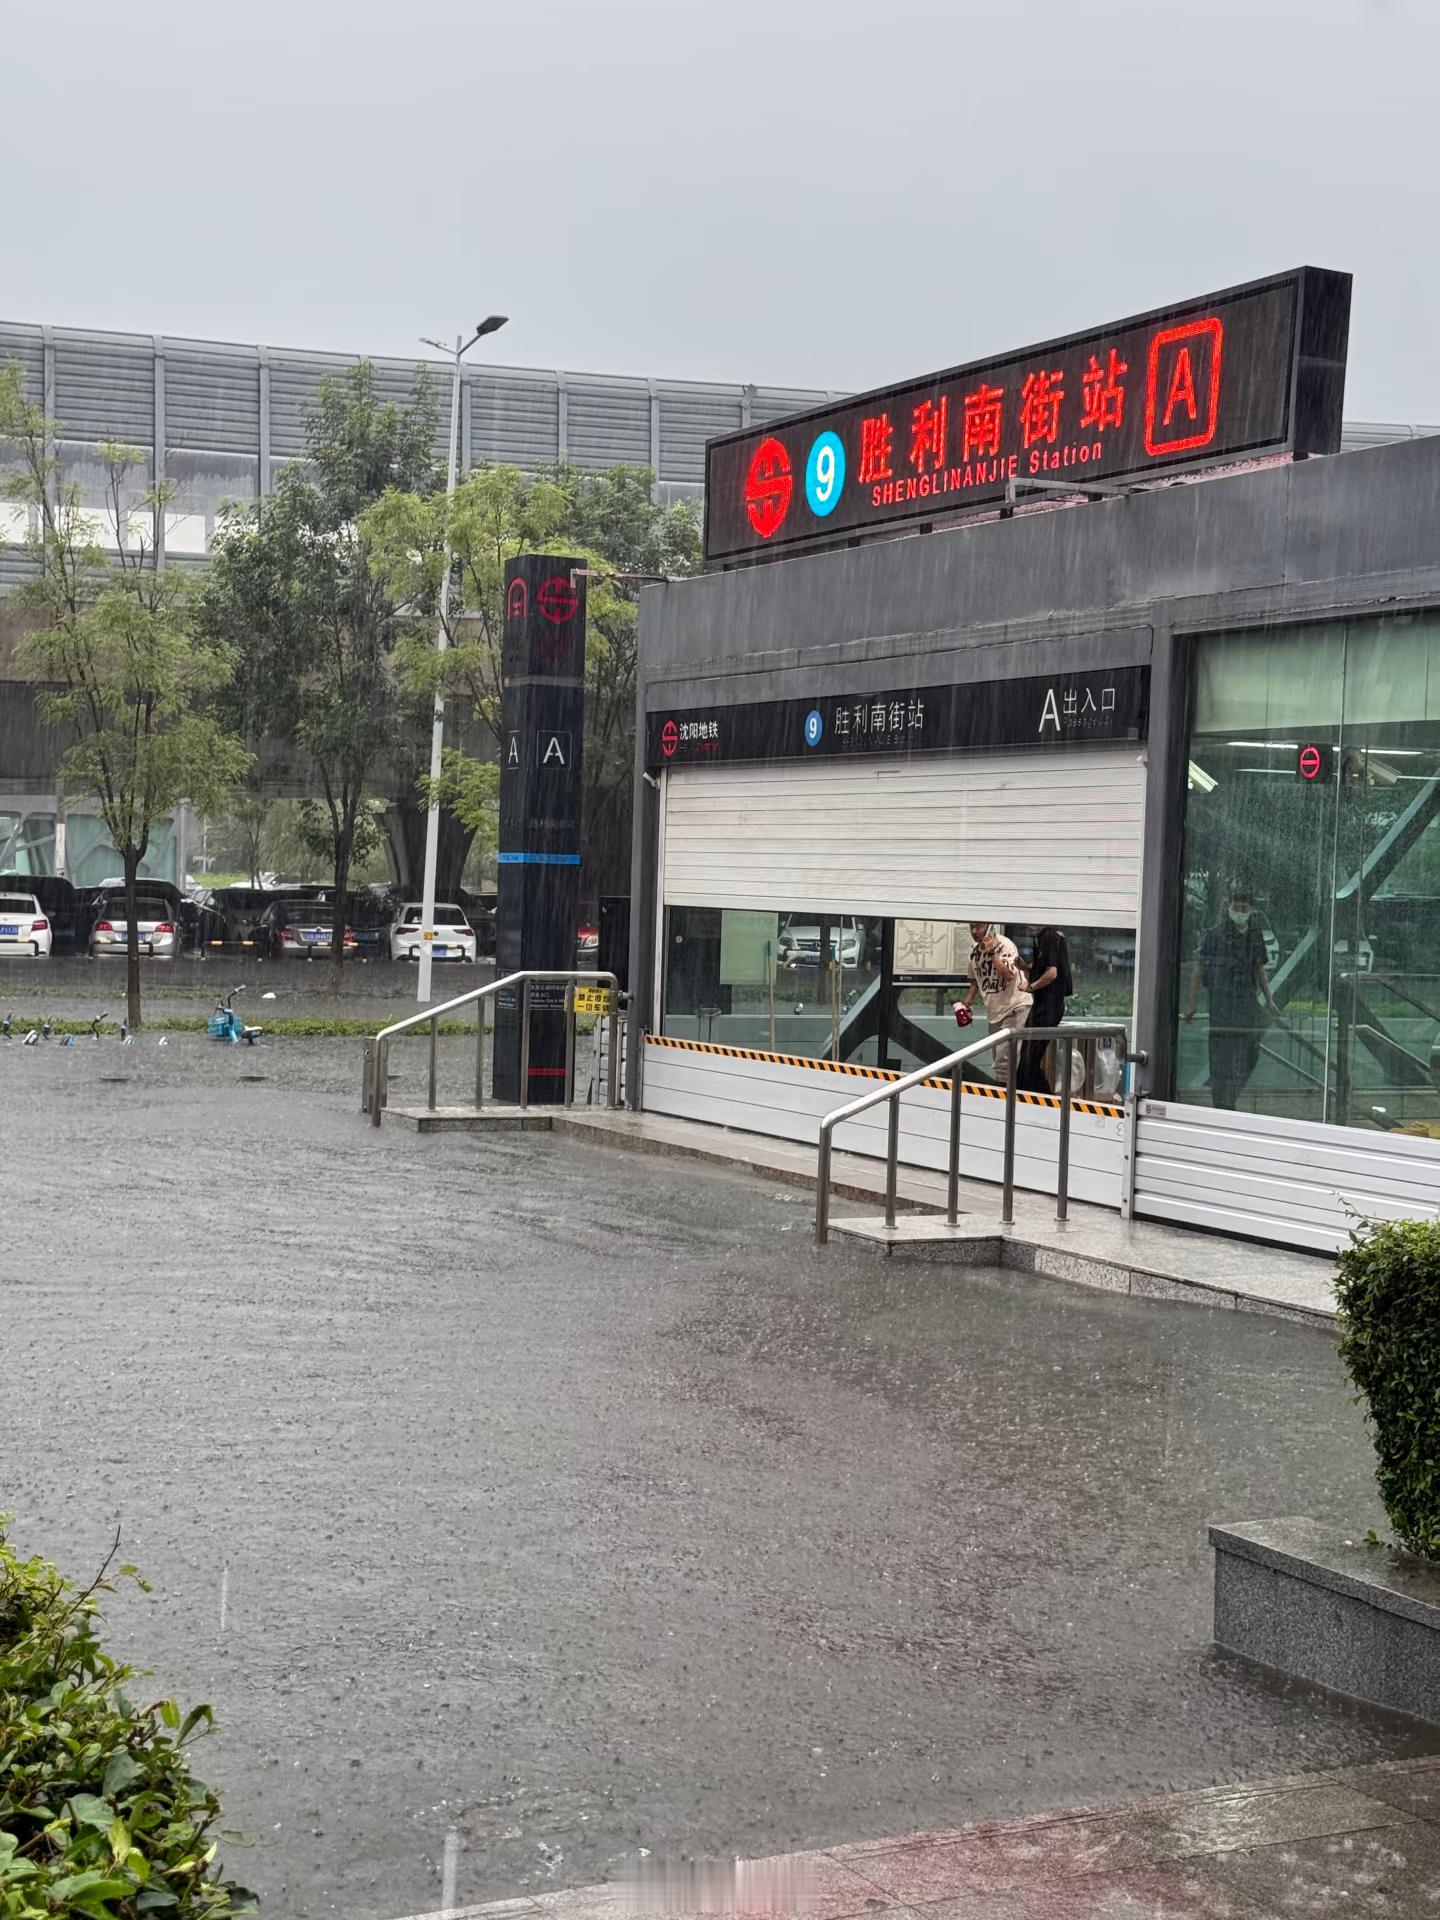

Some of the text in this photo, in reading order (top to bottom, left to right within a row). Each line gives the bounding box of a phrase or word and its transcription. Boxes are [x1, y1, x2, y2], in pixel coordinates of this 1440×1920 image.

[816, 347, 1197, 502] 9 胜利南街站 A
[872, 441, 1102, 507] SHENGLINANJIE Station
[680, 720, 718, 740] 沈阳地铁
[809, 698, 924, 739] 9 胜利南街站
[1038, 687, 1115, 732] A 出入口
[508, 736, 519, 764] A
[543, 737, 565, 764] A
